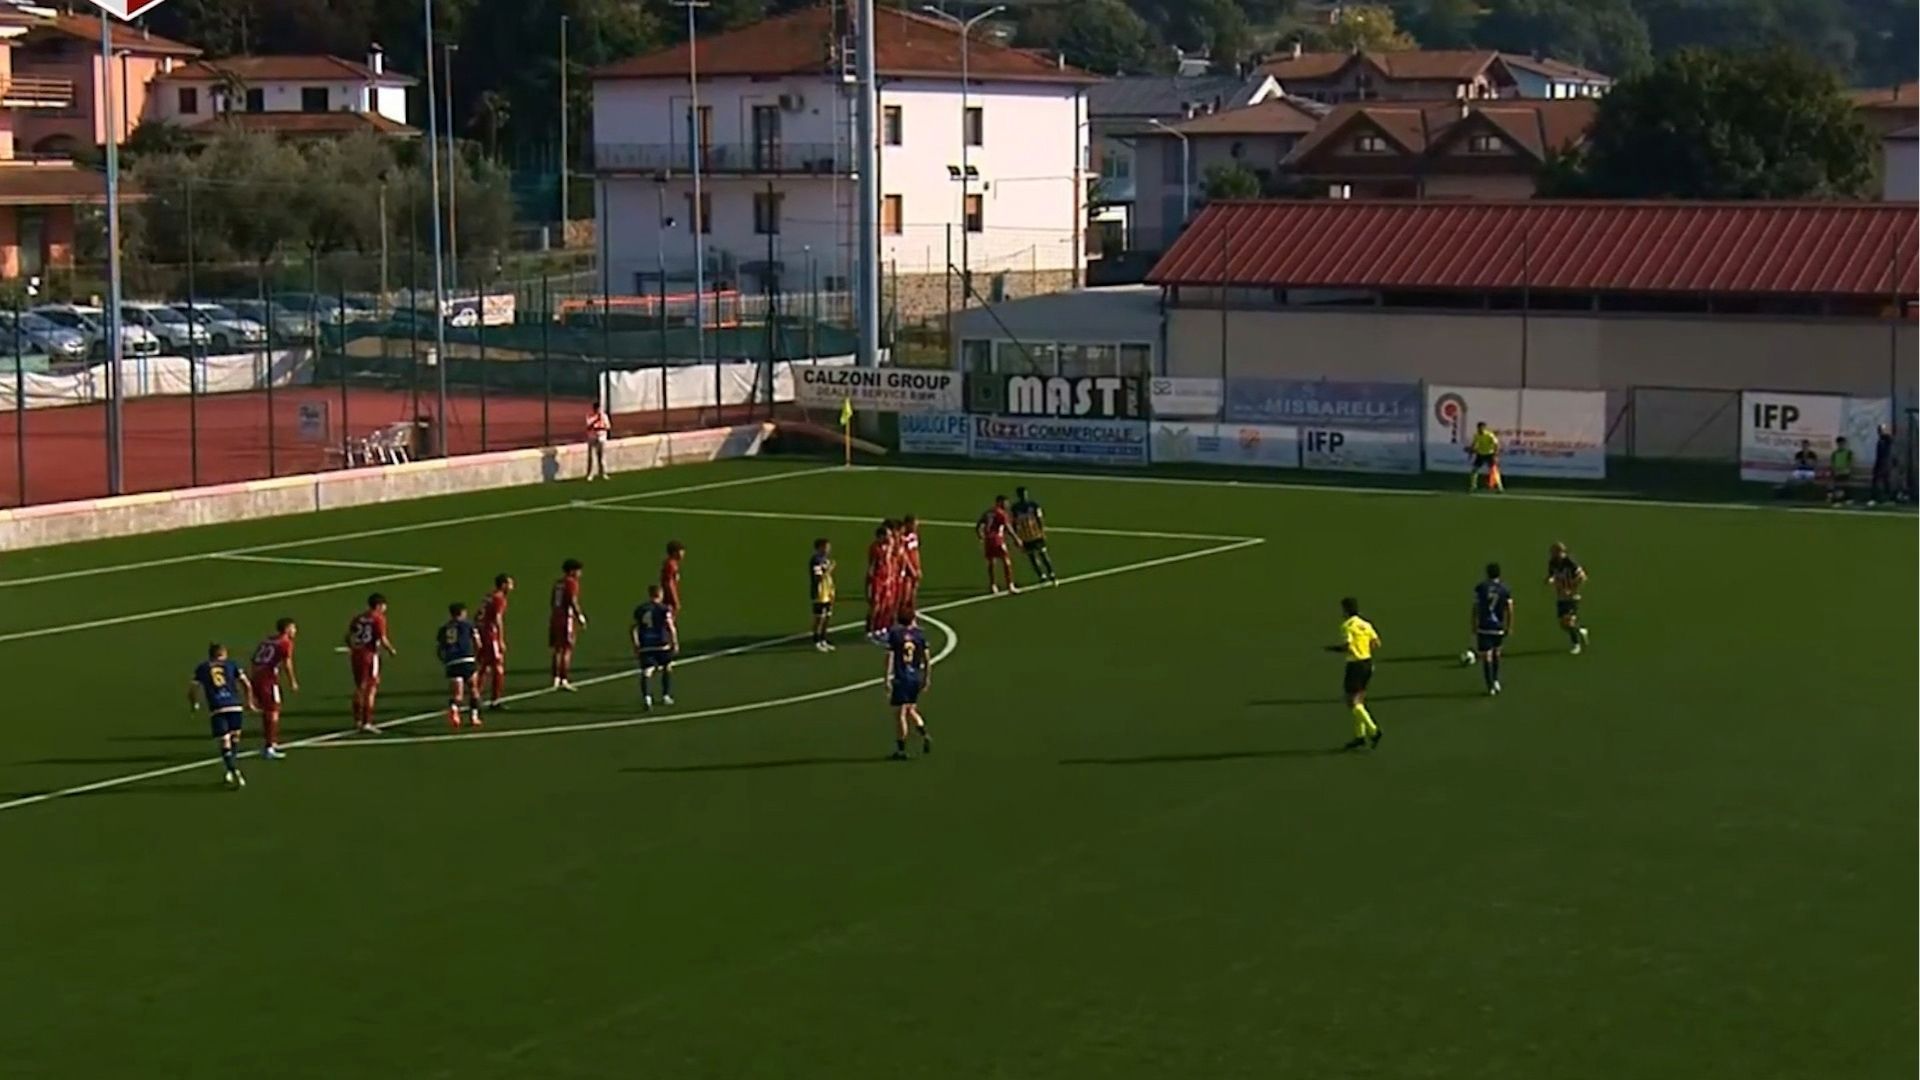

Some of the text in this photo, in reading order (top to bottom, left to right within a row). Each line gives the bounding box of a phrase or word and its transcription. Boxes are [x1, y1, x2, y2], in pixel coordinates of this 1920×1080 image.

[804, 370, 951, 390] CALZONI GROUP
[1008, 376, 1121, 416] MAST
[1754, 403, 1799, 430] IFP
[1307, 431, 1344, 453] IFP
[903, 641, 916, 662] 3
[210, 667, 226, 687] 6
